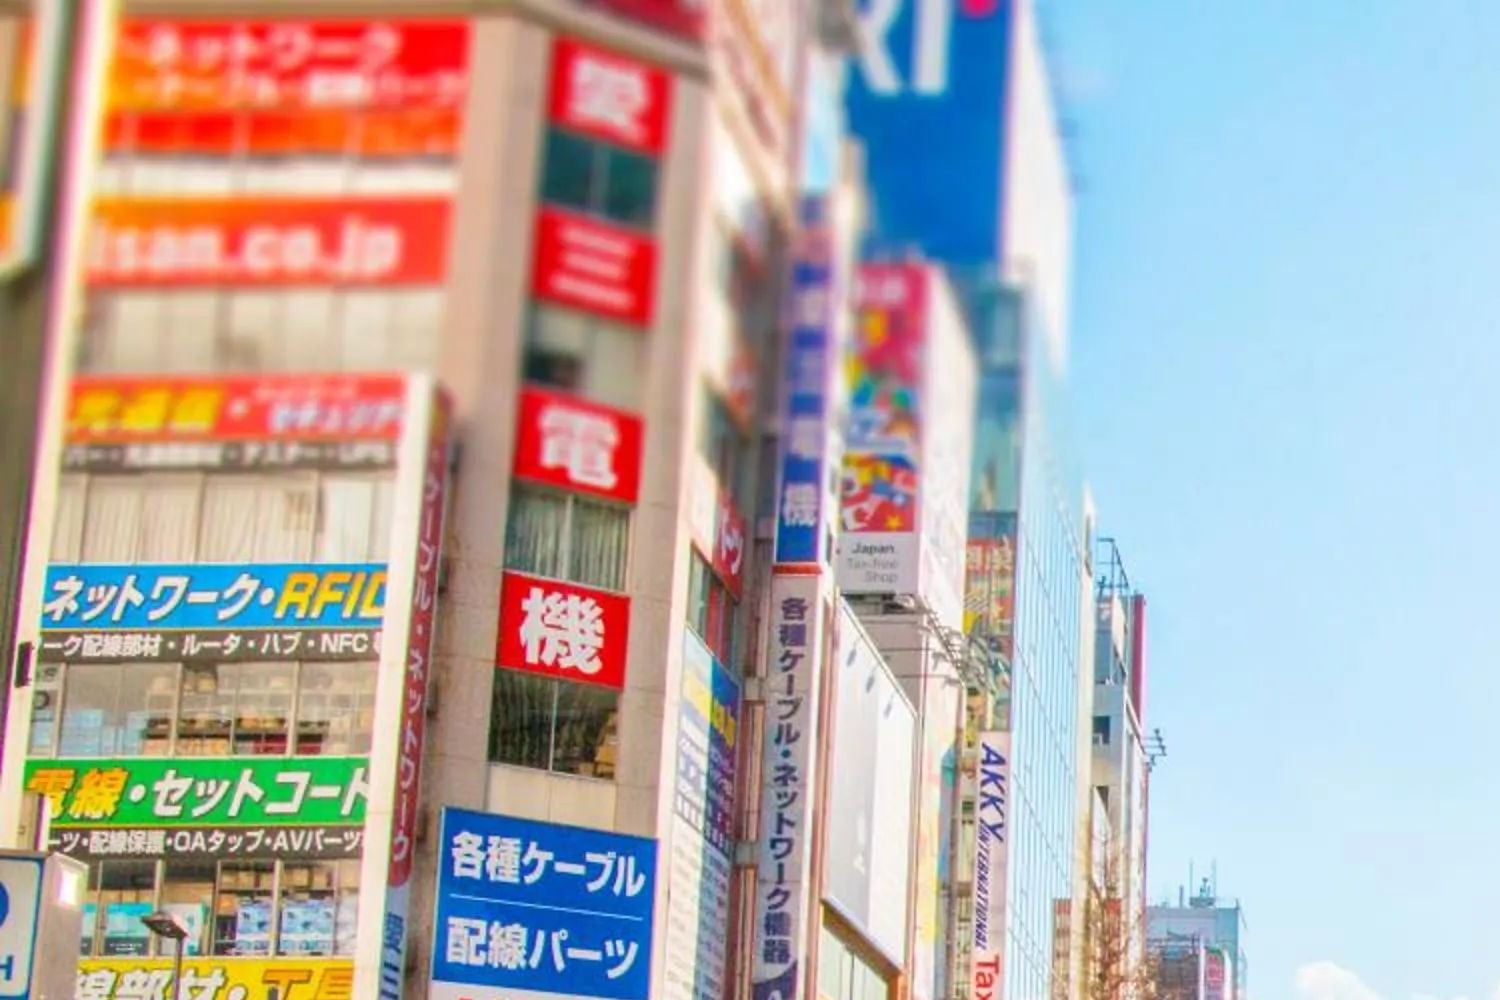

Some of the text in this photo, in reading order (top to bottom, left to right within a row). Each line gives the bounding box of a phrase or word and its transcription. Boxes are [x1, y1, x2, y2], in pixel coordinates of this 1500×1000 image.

[37, 633, 368, 658] ーク配線部材・ルータ・ハブ・NFC
[979, 742, 1006, 842] AKKY
[48, 829, 366, 855] ーツ・配線保護・OAタップ・AVパーツ
[451, 830, 646, 897] 各種ケーブル
[446, 916, 639, 979] 配線パーツ
